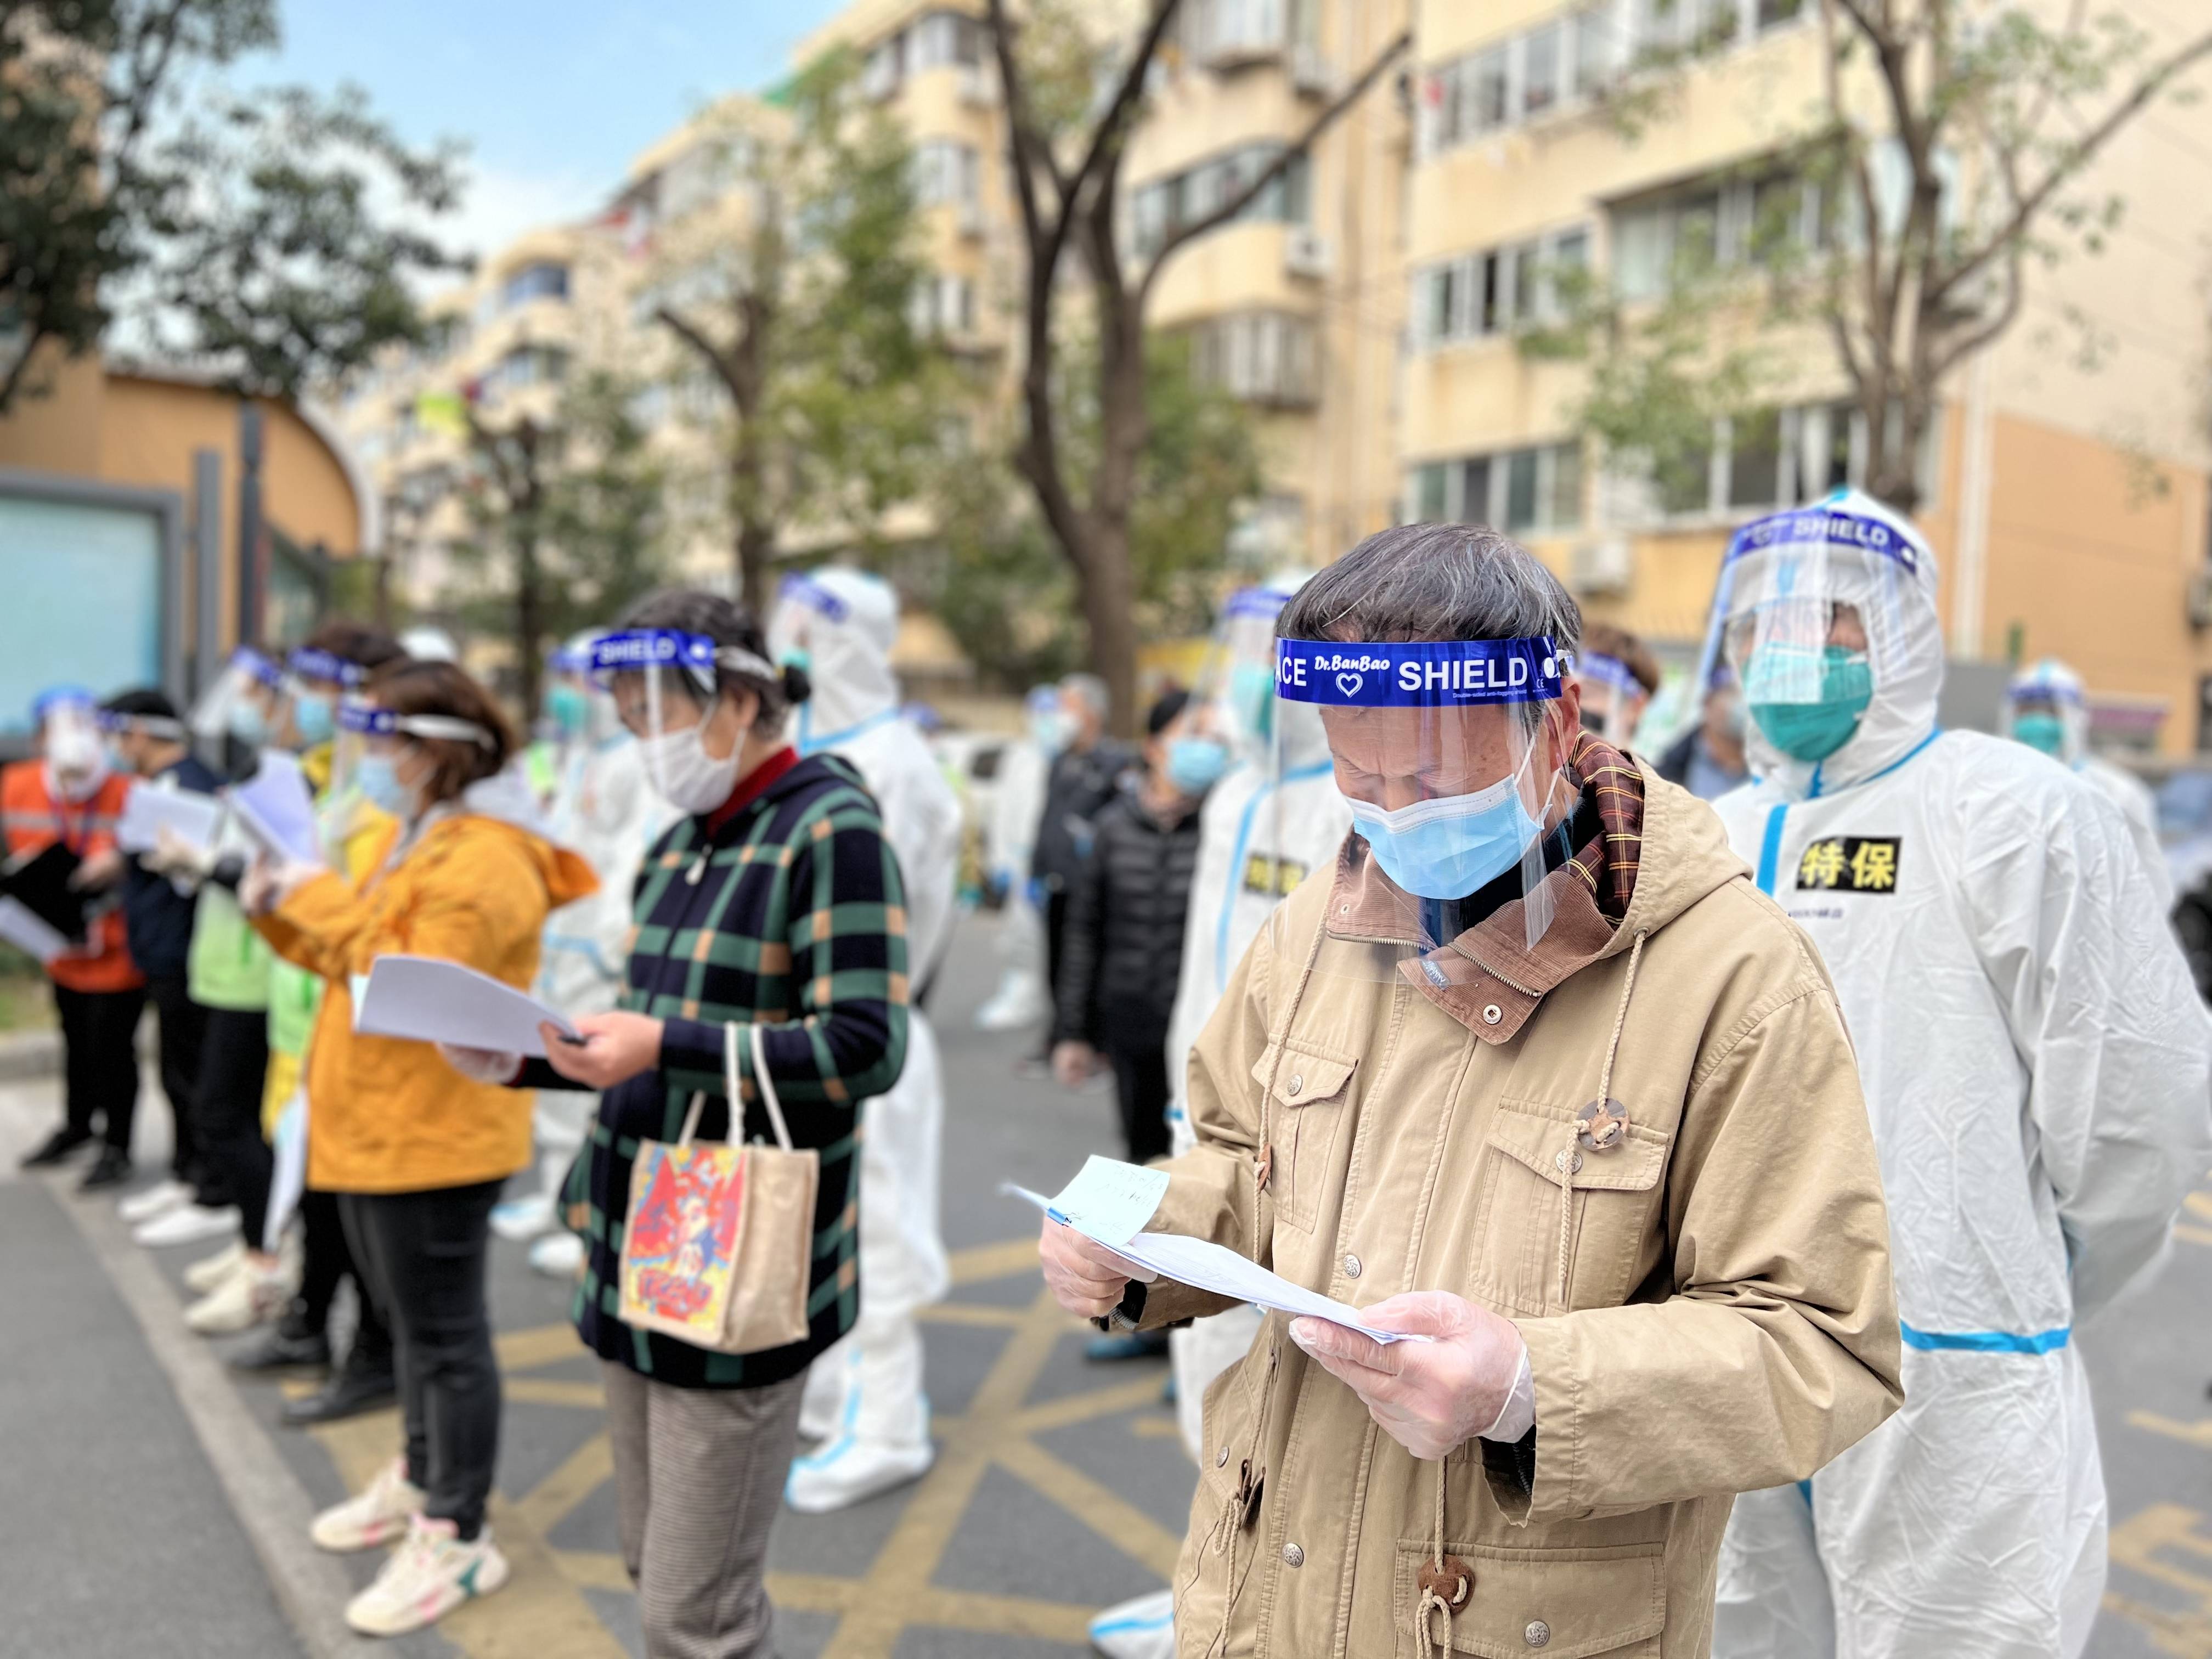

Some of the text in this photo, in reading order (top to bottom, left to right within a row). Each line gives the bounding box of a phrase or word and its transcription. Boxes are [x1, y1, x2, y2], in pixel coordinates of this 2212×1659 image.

[1793, 517, 1889, 546] SHIELD
[598, 636, 676, 665] SHIELD
[1398, 657, 1528, 691] SHIELD
[1801, 840, 1895, 889] 特保
